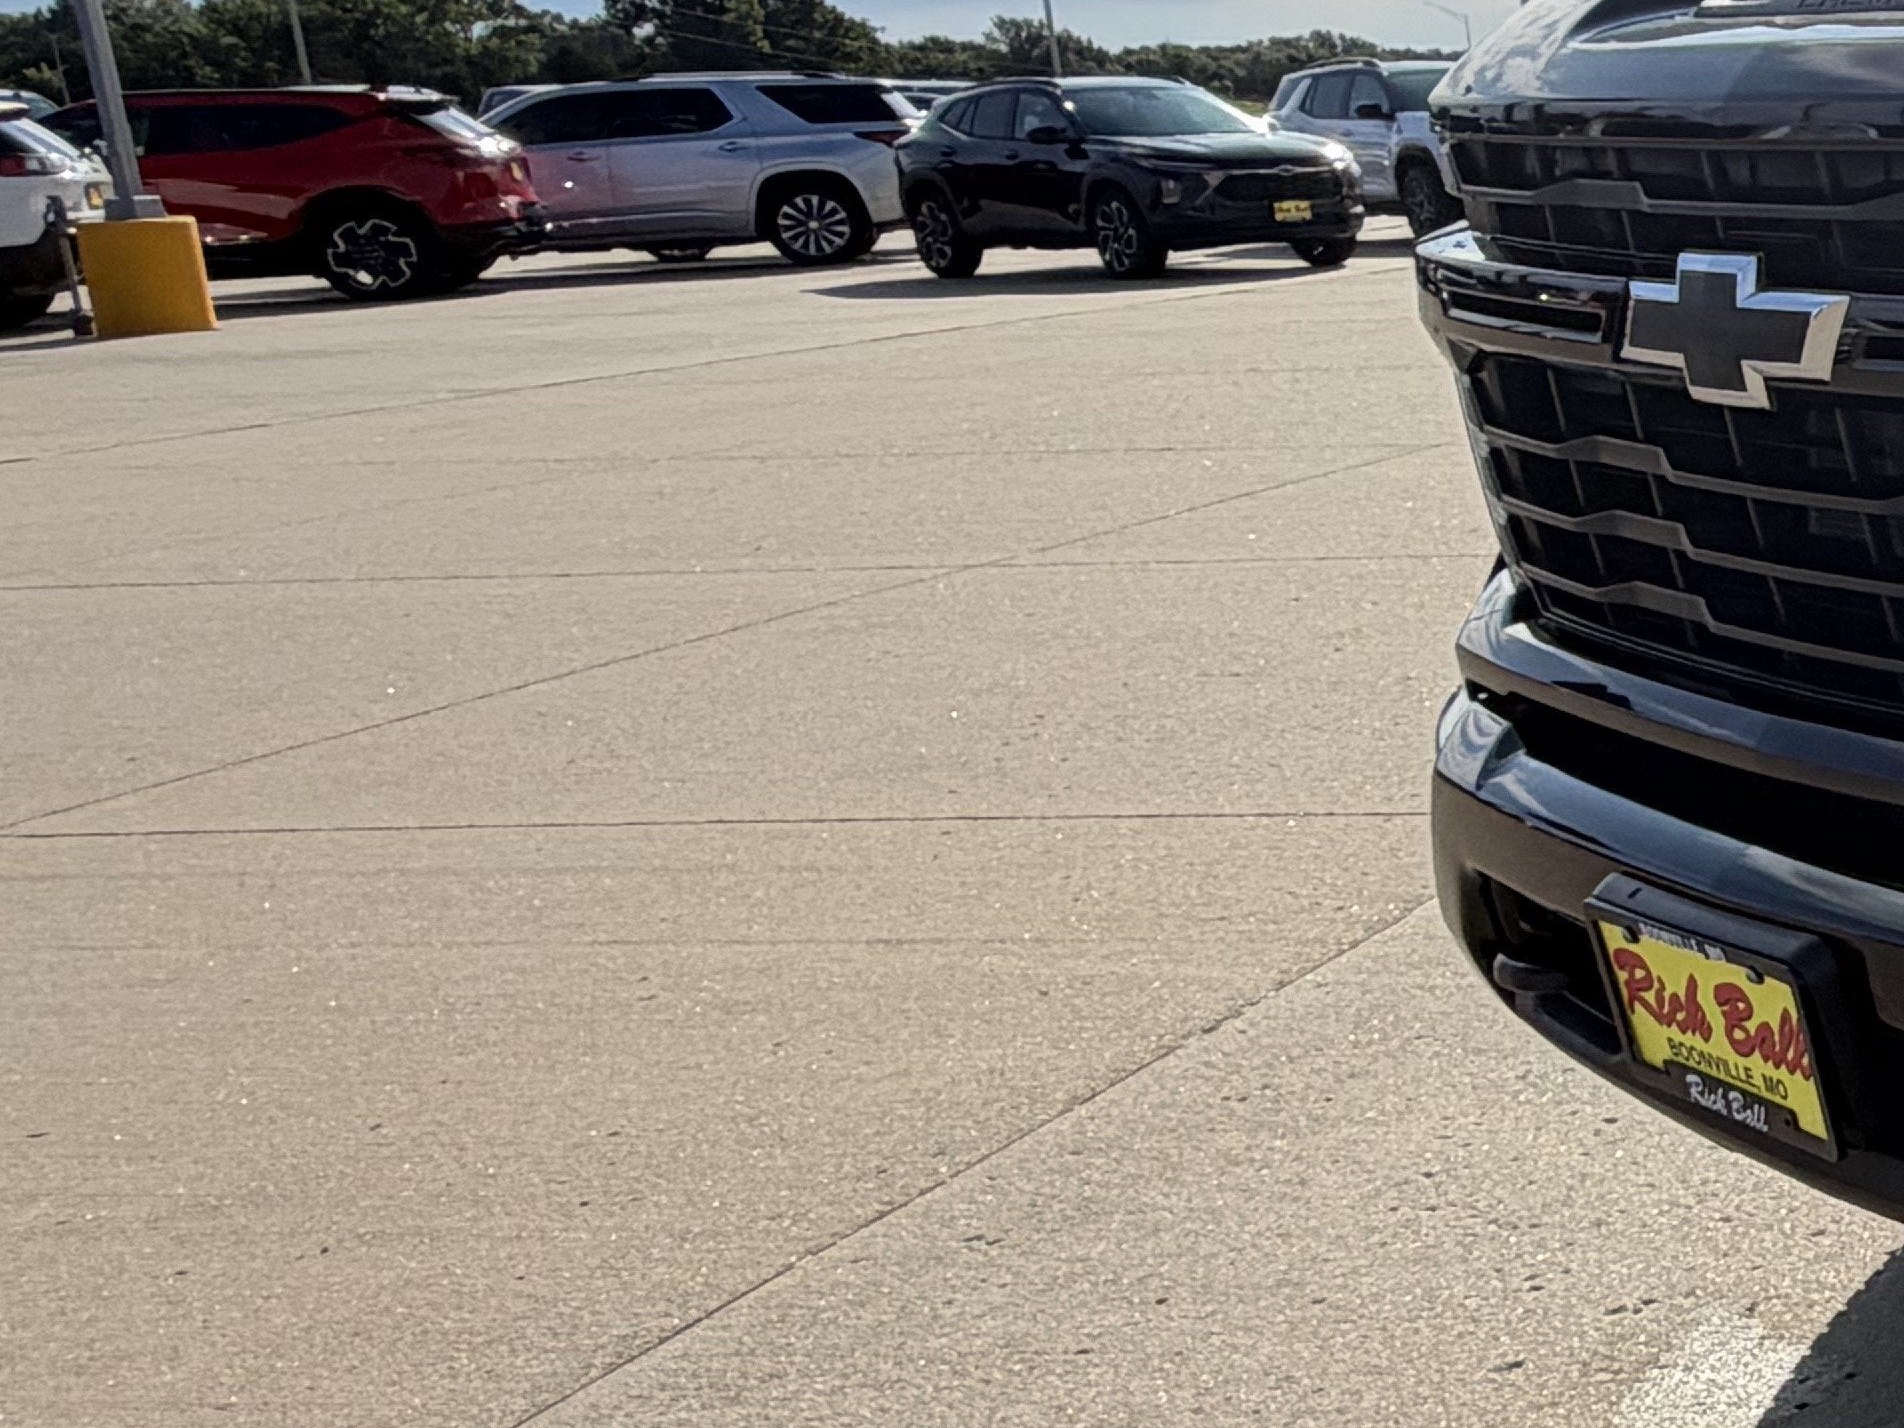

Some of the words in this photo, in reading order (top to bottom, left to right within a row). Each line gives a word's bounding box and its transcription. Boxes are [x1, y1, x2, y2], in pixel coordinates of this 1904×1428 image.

[1613, 947, 1713, 1044] Rick
[1713, 982, 1814, 1081] Ball
[1686, 1074, 1728, 1116] Rick
[1728, 1097, 1769, 1133] Ball
[1762, 1073, 1789, 1101] MO
